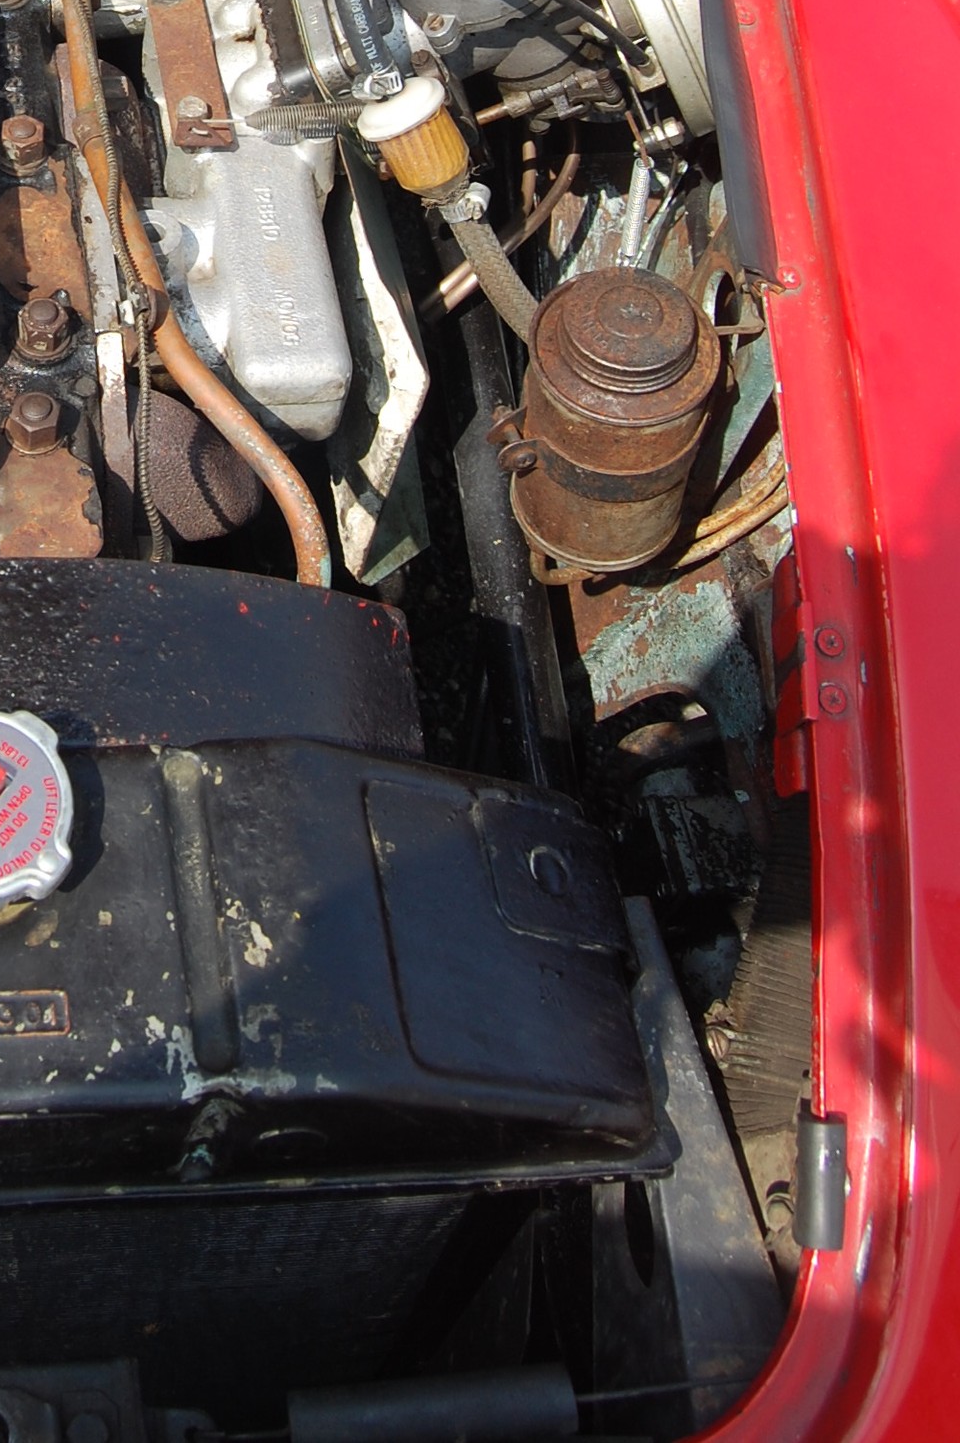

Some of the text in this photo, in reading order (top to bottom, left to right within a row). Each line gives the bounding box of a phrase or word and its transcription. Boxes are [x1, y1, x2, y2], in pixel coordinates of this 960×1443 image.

[273, 288, 301, 346] MOWOG
[16, 756, 30, 768] 13
[6, 785, 32, 812] OPEN
[43, 776, 59, 801] LIFT
[11, 811, 29, 828] DO
[41, 802, 59, 841] LEVER
[31, 839, 48, 854] TO
